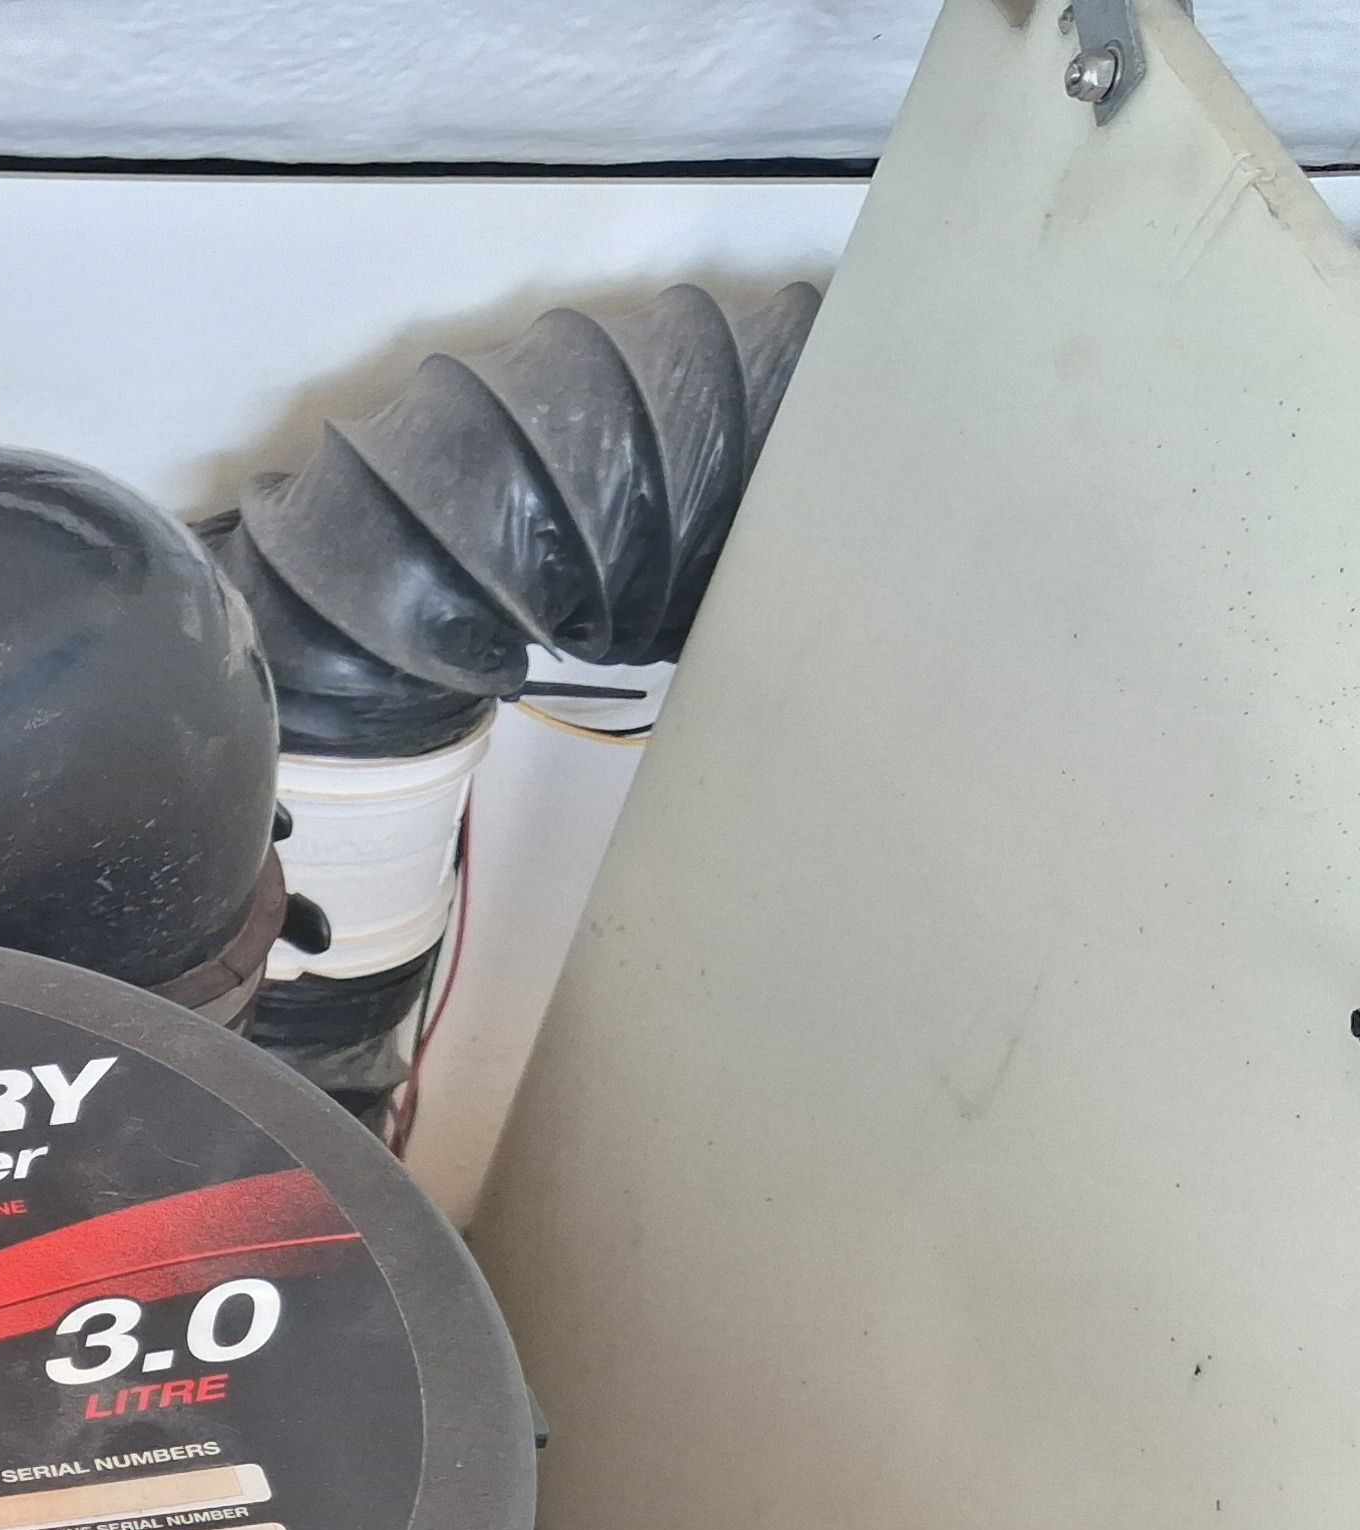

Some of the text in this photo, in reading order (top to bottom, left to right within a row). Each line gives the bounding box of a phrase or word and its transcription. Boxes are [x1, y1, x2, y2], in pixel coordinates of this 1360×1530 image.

[45, 1278, 281, 1386] 3.0
[85, 1373, 229, 1420] LITRE
[1, 1441, 221, 1484] SERIAL NUMBERS
[167, 1506, 249, 1527] NUMBER
